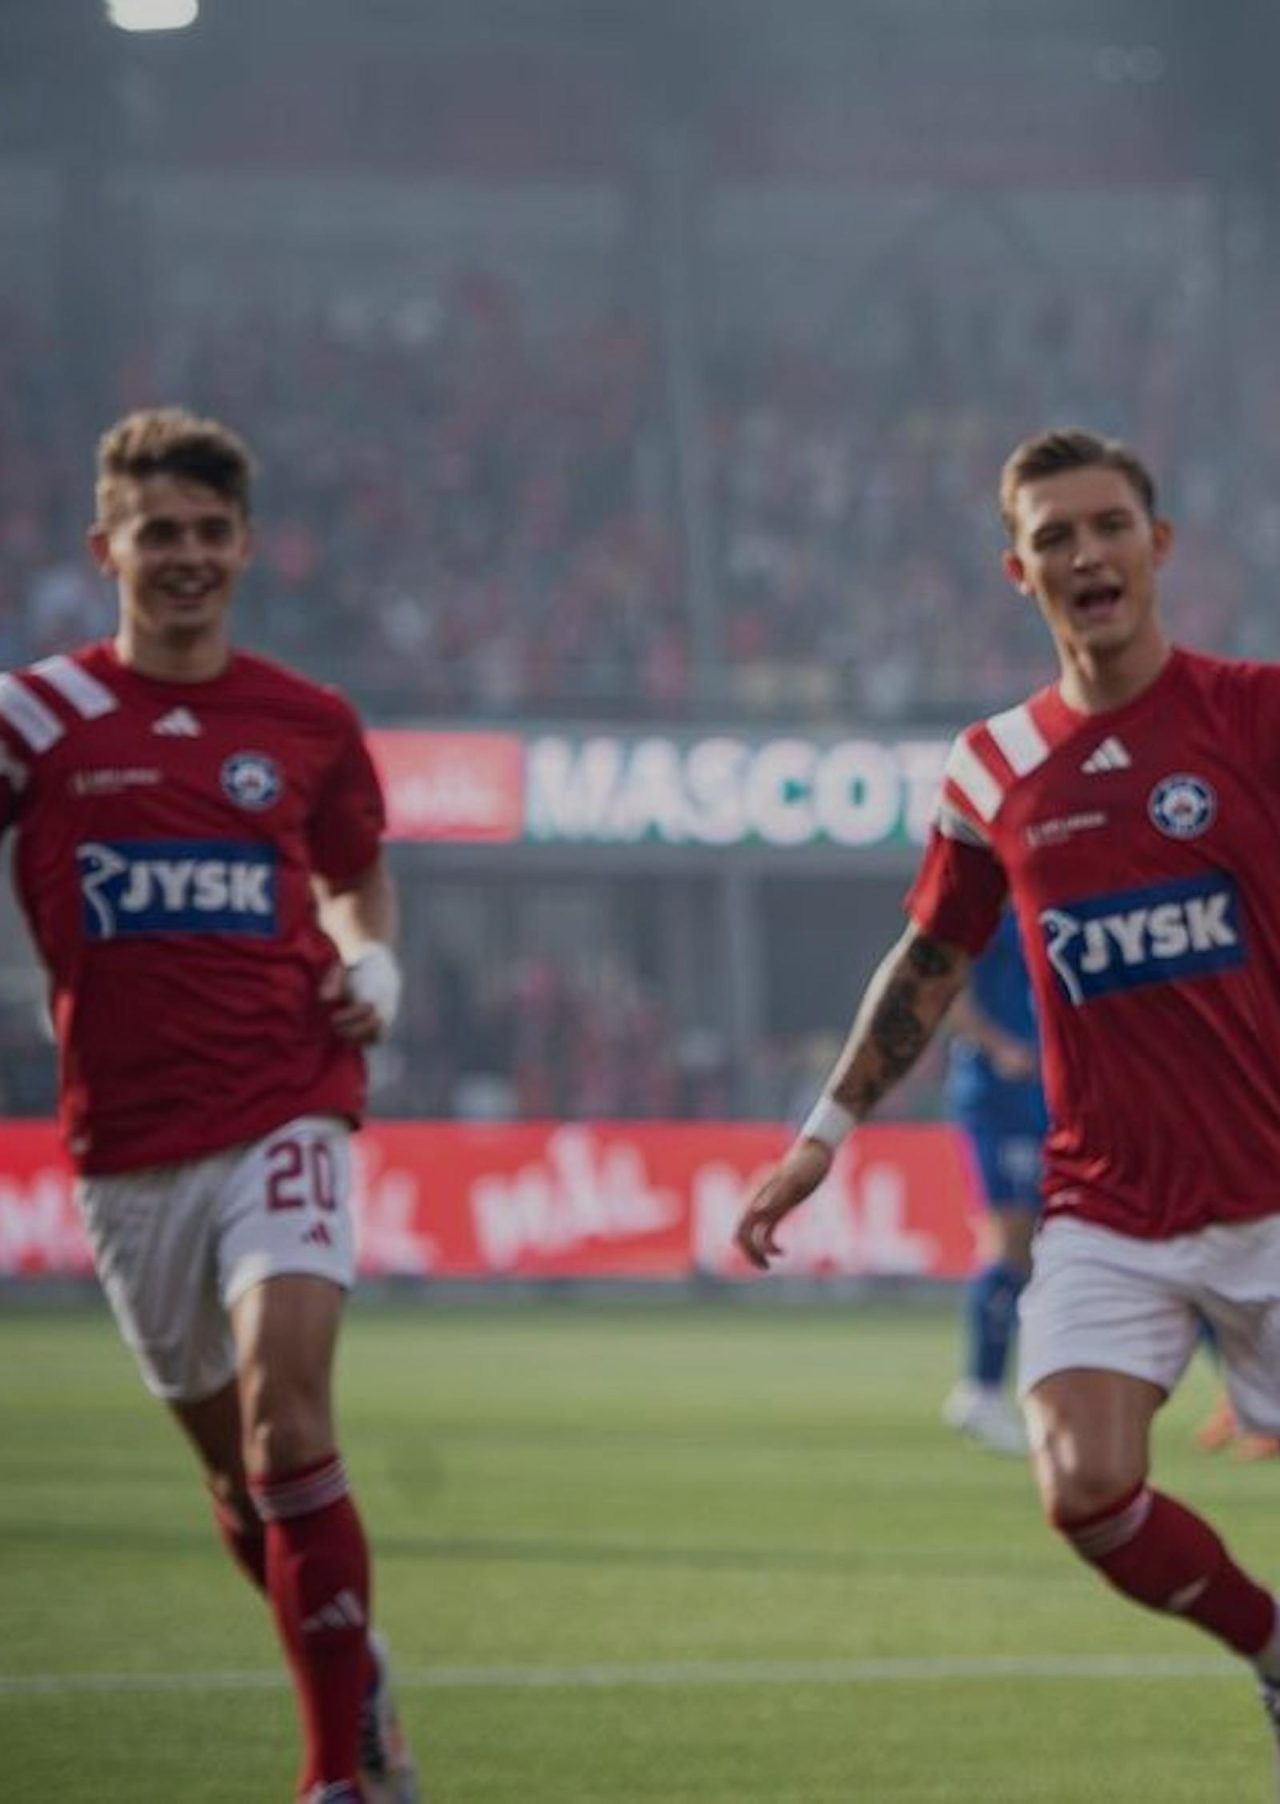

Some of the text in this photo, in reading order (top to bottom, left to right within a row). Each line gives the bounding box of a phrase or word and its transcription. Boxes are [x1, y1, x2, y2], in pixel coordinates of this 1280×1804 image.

[121, 861, 272, 914] JYSK
[1080, 893, 1236, 973] JYSK
[266, 1140, 336, 1212] 20
